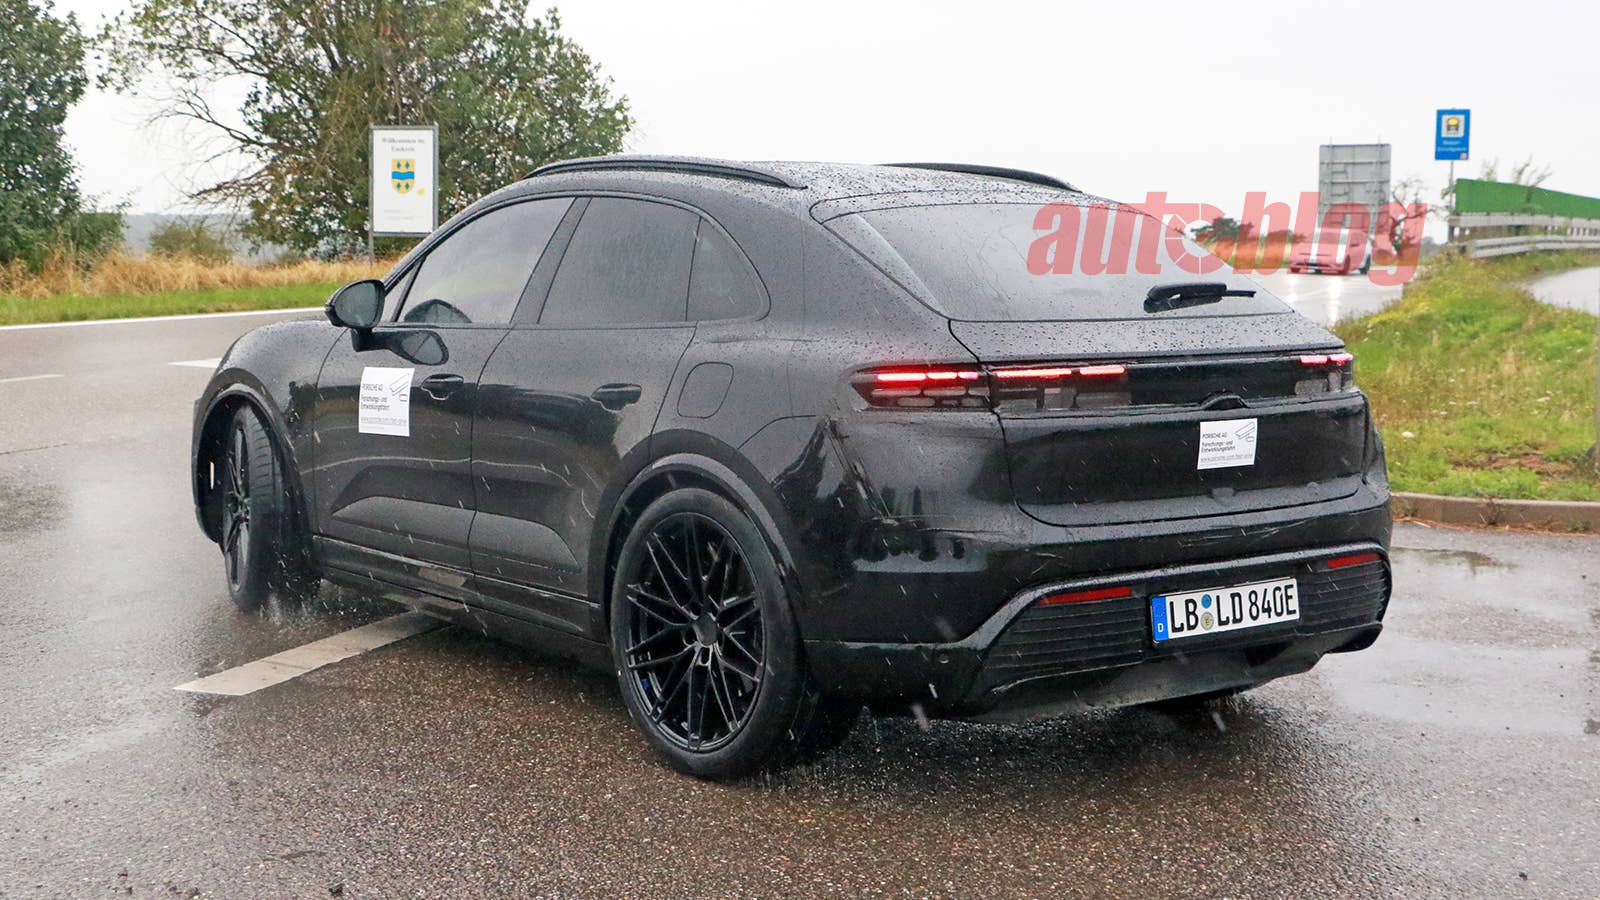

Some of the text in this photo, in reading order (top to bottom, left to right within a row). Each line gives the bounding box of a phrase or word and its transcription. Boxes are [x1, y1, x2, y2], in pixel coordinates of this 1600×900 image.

[1158, 584, 1296, 633] D LB LD 840E
